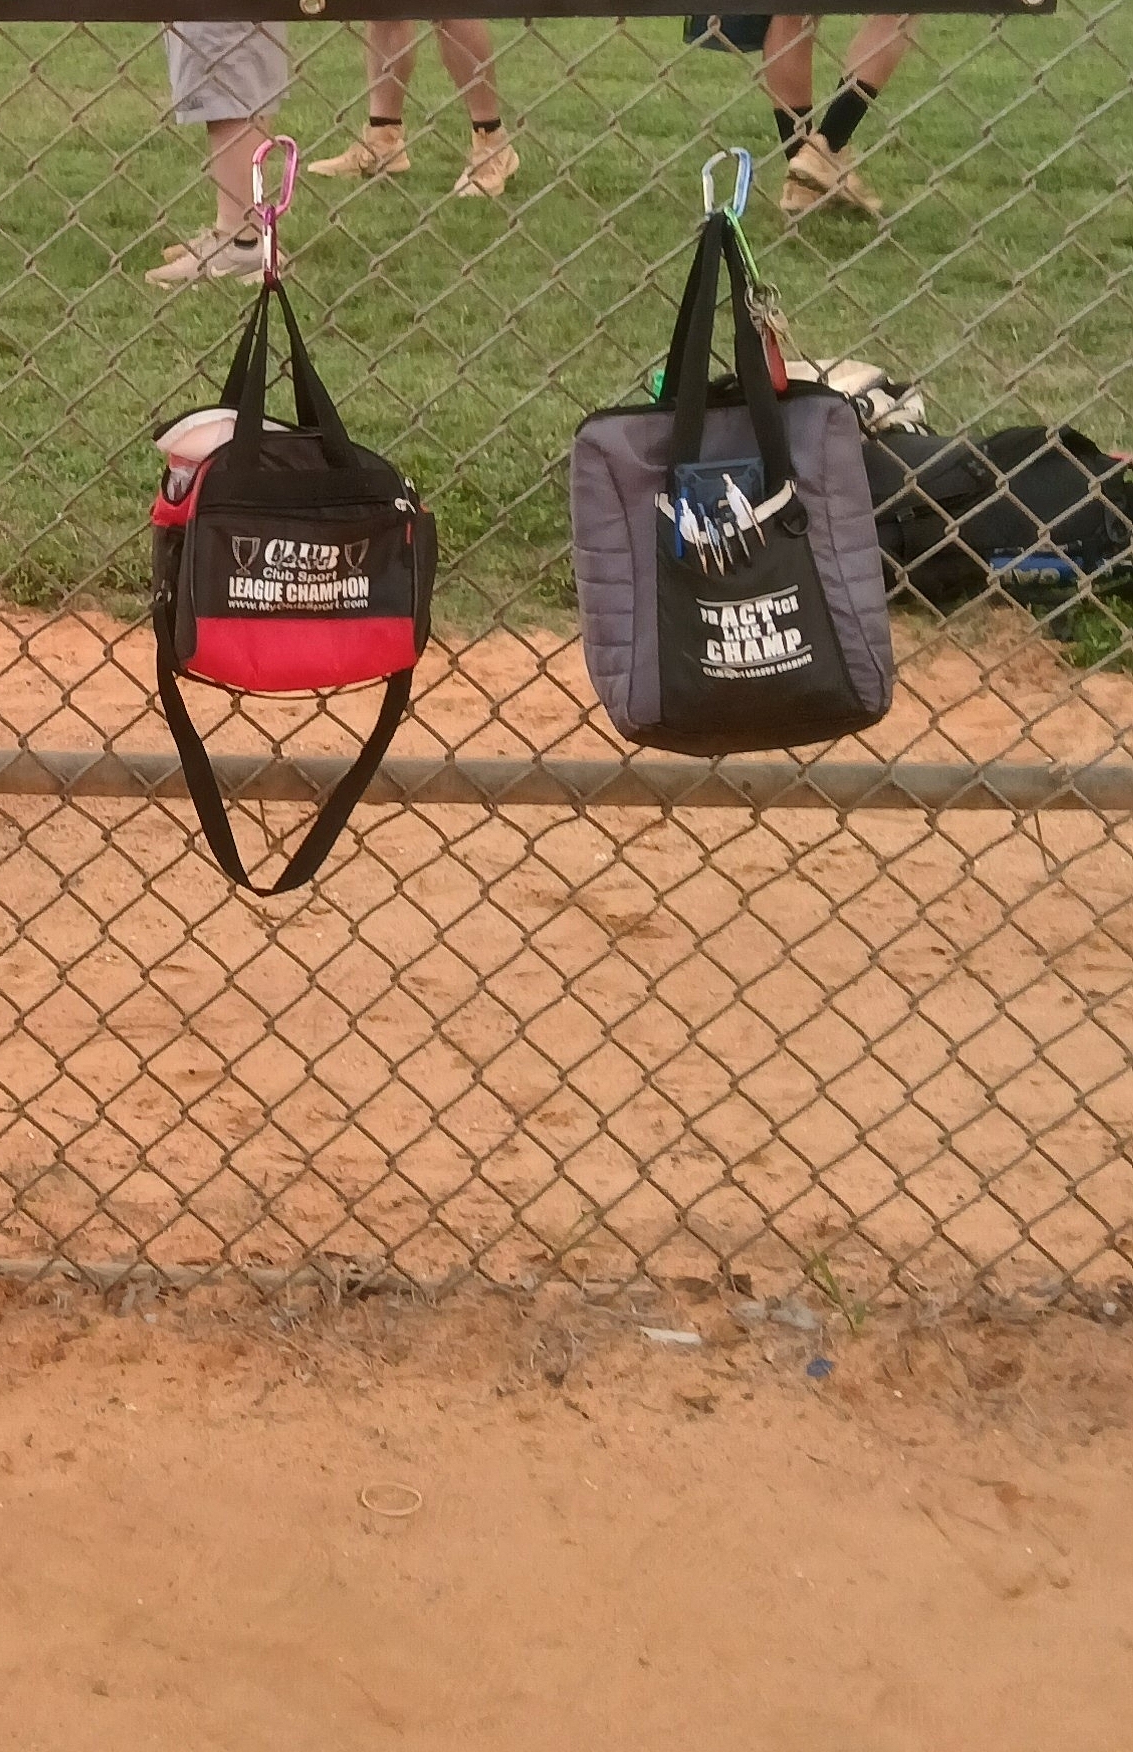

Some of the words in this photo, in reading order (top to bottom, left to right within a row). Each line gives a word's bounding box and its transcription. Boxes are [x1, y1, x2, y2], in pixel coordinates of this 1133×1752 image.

[262, 566, 295, 582] Club
[297, 569, 338, 584] Sport
[228, 575, 284, 603] LEAGUE
[285, 575, 370, 603] CHAMPION
[723, 623, 762, 641] LIKE
[766, 619, 777, 635] A
[706, 627, 802, 663] CHAMP
